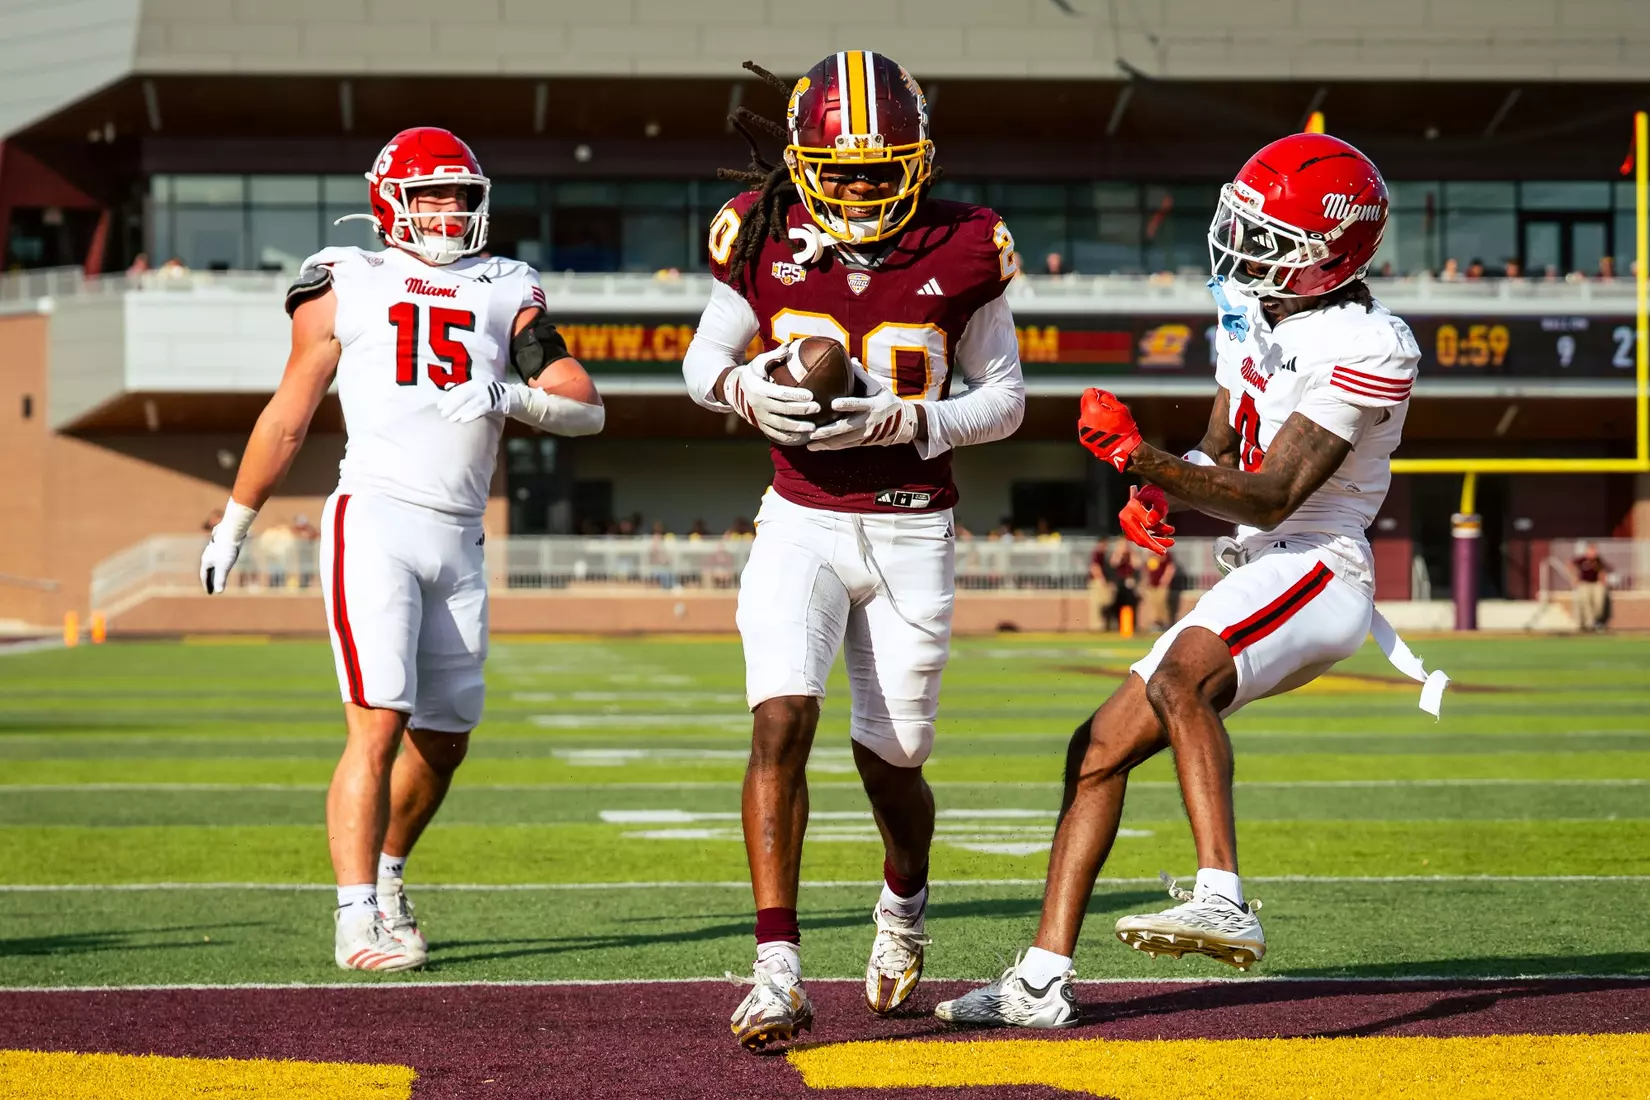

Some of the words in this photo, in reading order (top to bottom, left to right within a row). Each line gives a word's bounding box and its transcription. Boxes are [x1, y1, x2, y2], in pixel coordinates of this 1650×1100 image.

[1322, 193, 1381, 222] Miami
[405, 277, 460, 298] Miami
[388, 301, 476, 392] 15
[1436, 325, 1510, 367] 0:59
[1557, 335, 1576, 368] 9
[1612, 325, 1636, 368] 2
[1240, 355, 1274, 393] Miami
